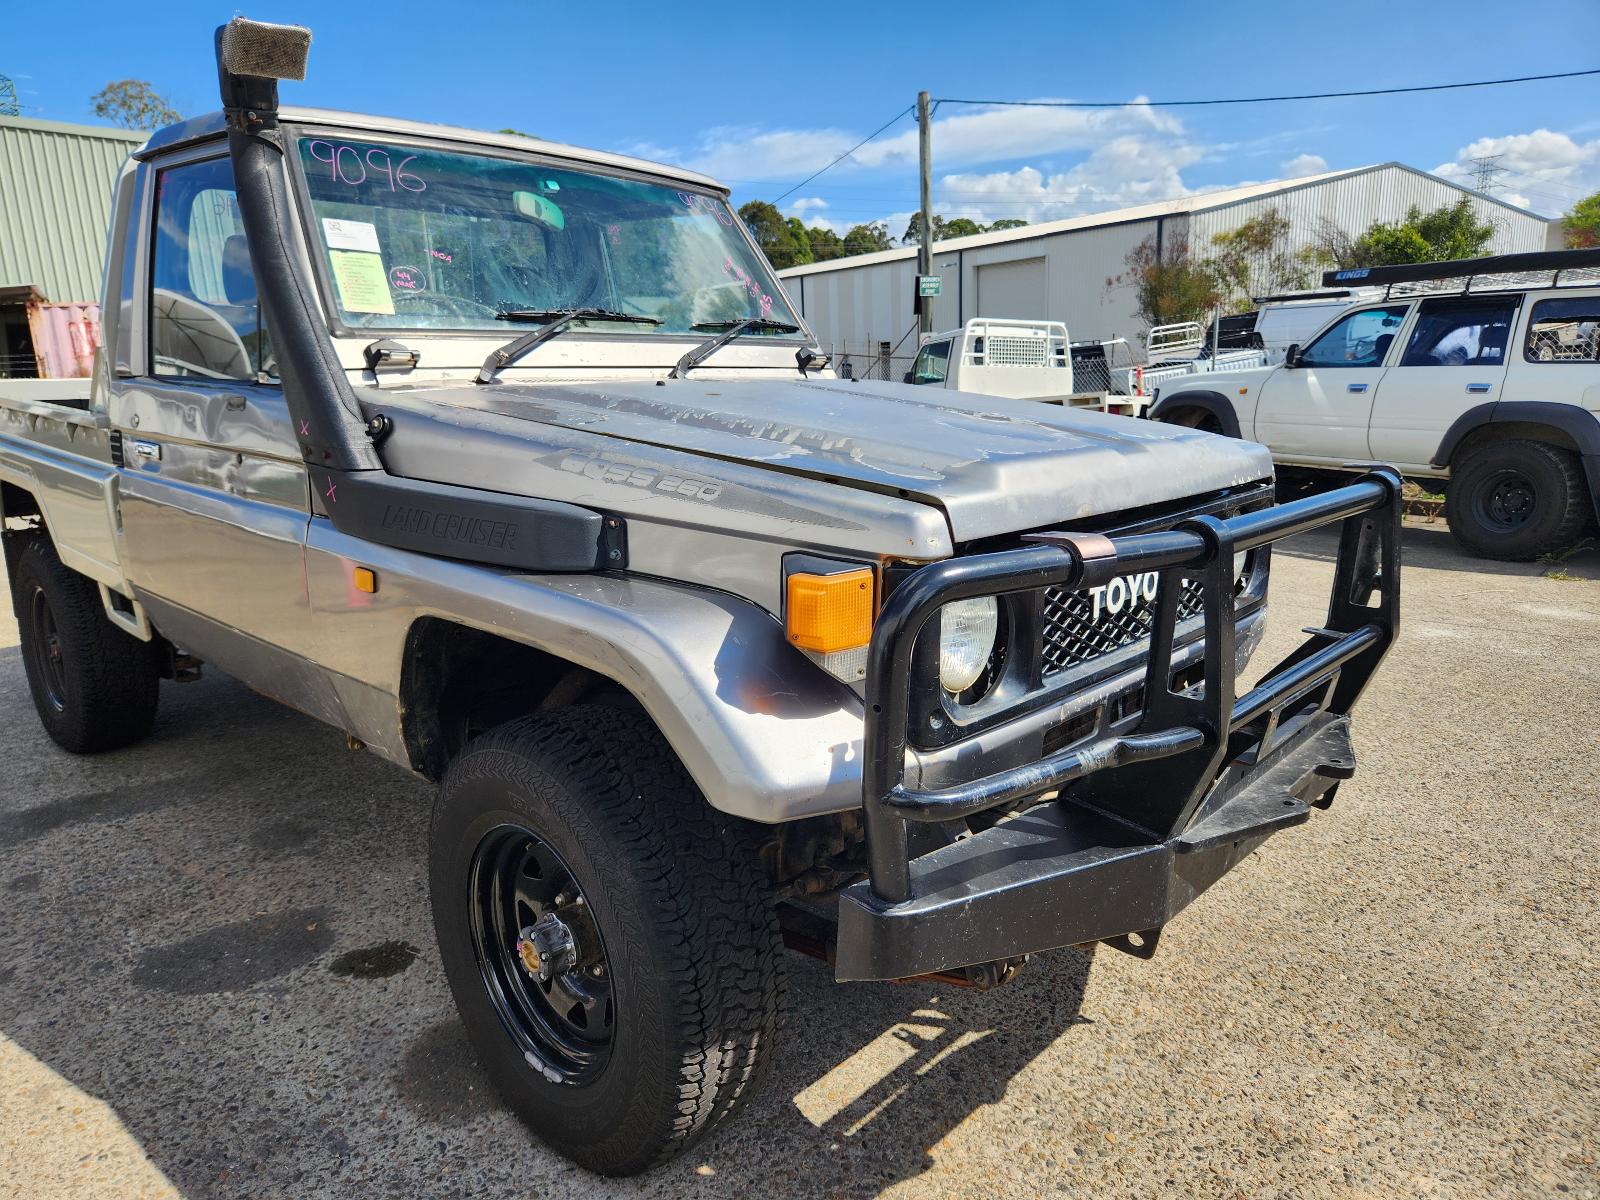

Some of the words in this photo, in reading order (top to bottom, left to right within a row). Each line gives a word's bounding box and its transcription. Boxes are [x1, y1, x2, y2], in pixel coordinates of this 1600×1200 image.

[310, 140, 427, 193] 9096
[1335, 269, 1370, 280] KINGS
[381, 504, 431, 534] LAND
[431, 513, 521, 550] CRUISER
[1089, 571, 1160, 619] TOYO
